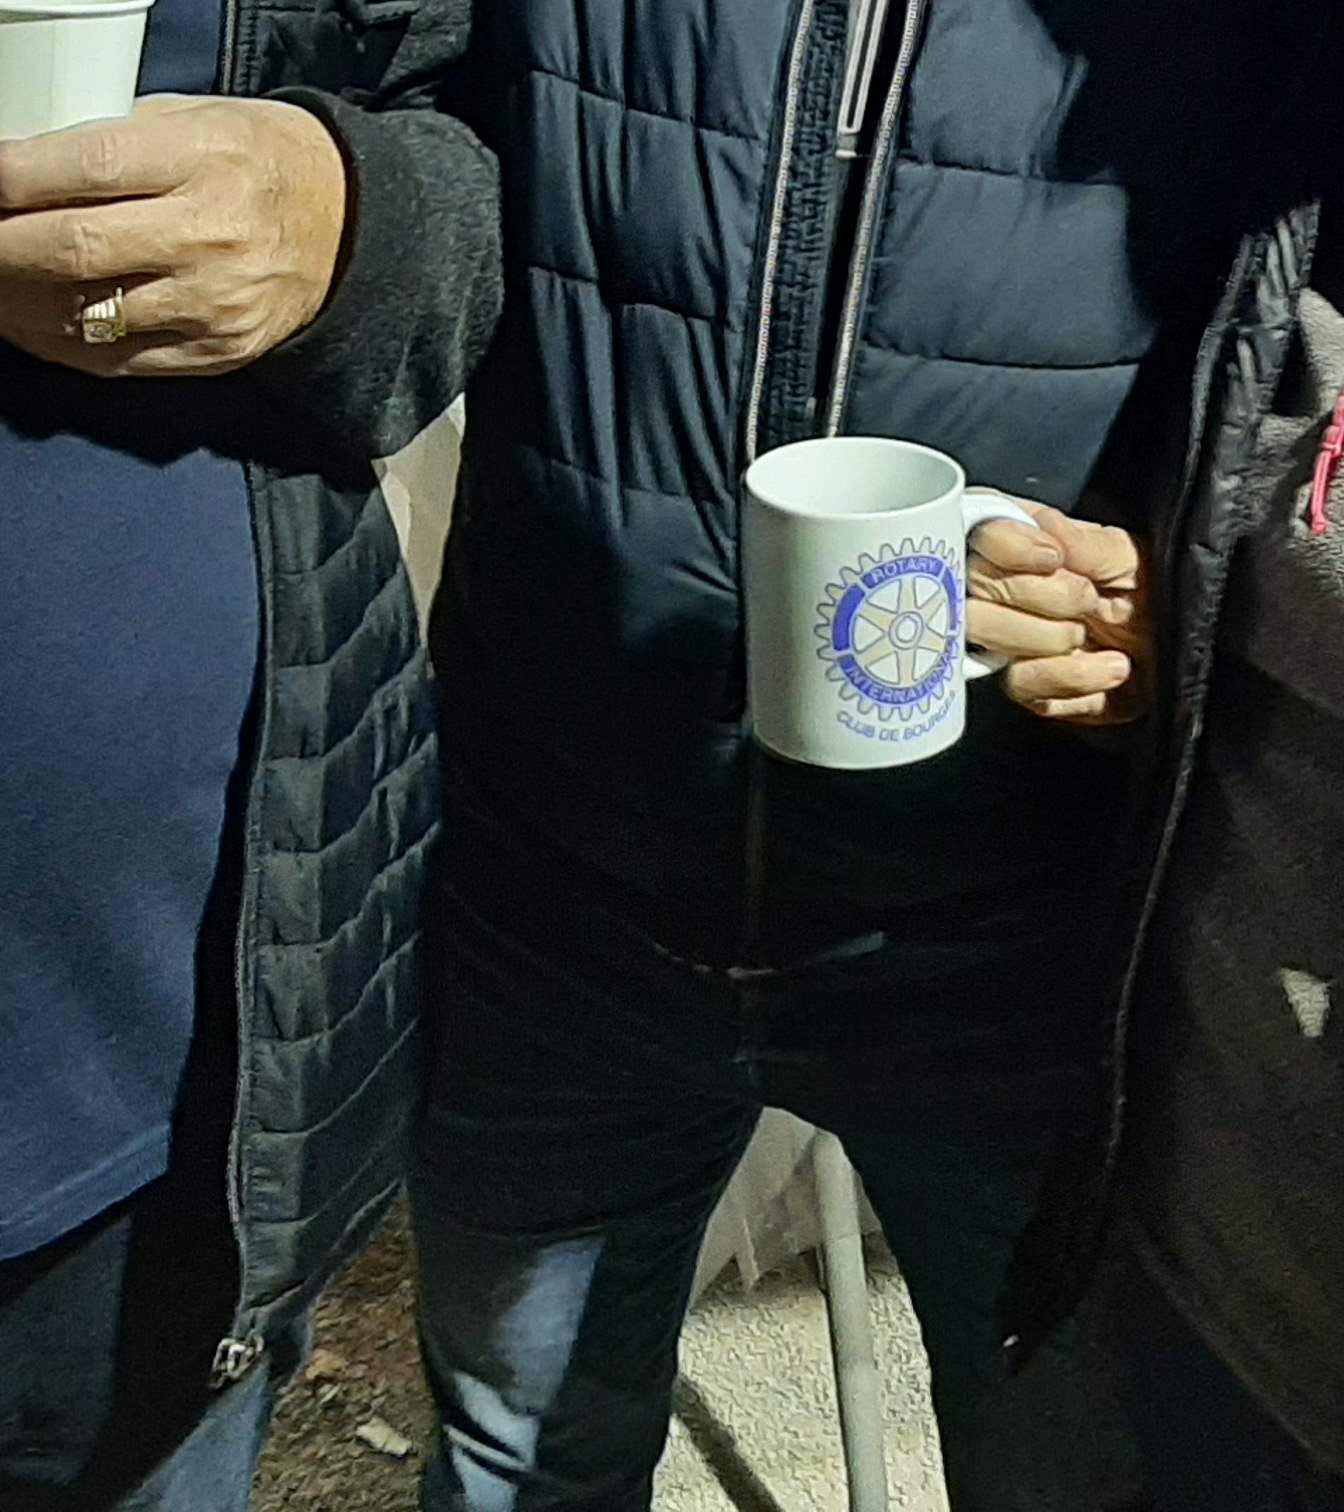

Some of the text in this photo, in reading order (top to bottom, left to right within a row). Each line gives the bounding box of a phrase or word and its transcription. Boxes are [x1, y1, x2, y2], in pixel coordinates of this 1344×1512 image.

[872, 557, 938, 584] ROTARY
[836, 710, 875, 739] CLUB
[879, 727, 899, 741] DE
